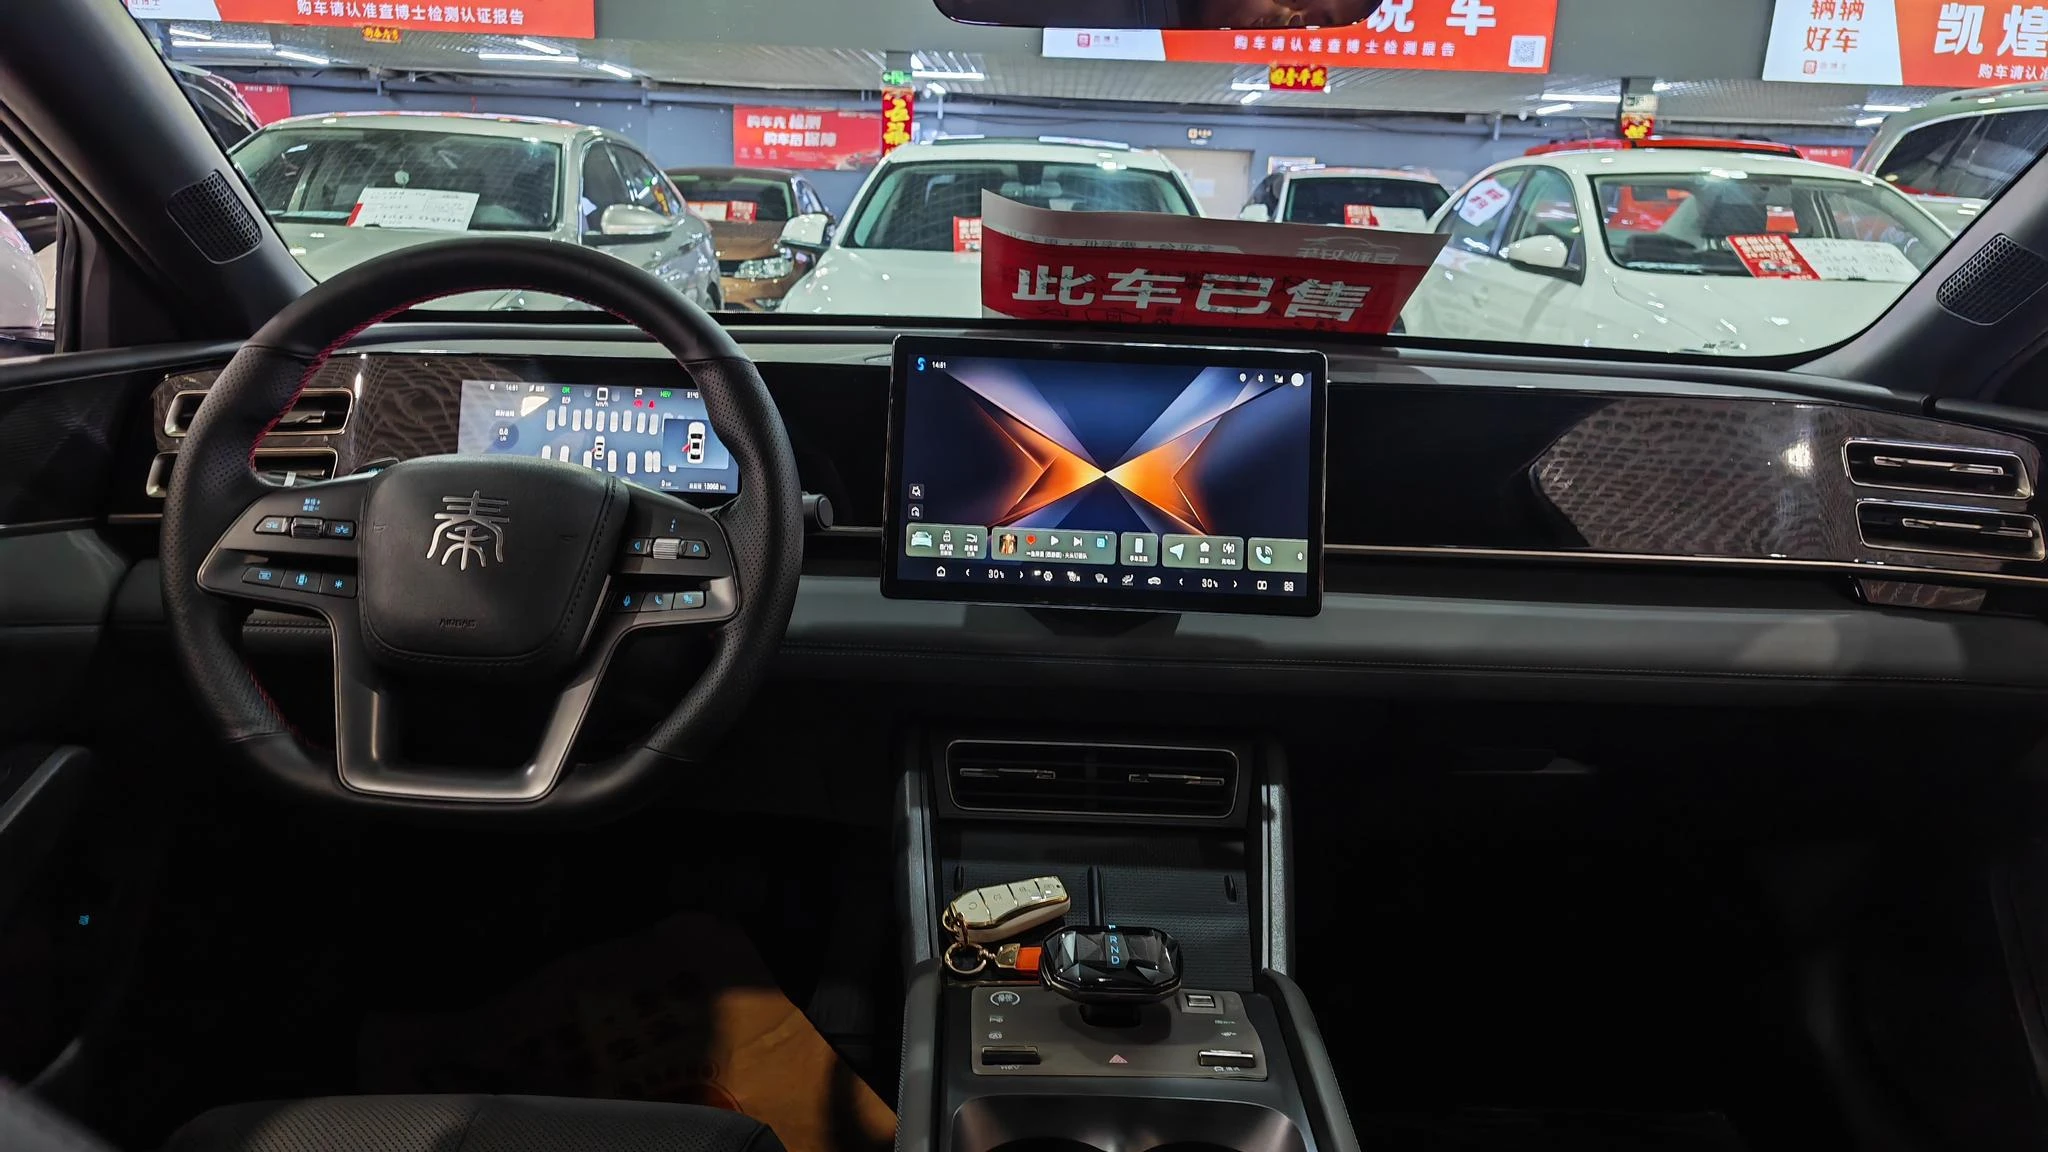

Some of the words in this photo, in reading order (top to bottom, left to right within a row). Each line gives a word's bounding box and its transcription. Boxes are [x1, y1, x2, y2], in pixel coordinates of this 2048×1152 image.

[297, 0, 525, 25] 购车请认准查博士检测认证报告
[1803, 27, 1860, 53] 好车
[1934, 4, 2048, 58] 凯煌
[1233, 34, 1456, 57] 购车请认准查博士检测报告
[1012, 264, 1373, 322] 此车已售
[634, 388, 643, 398] P
